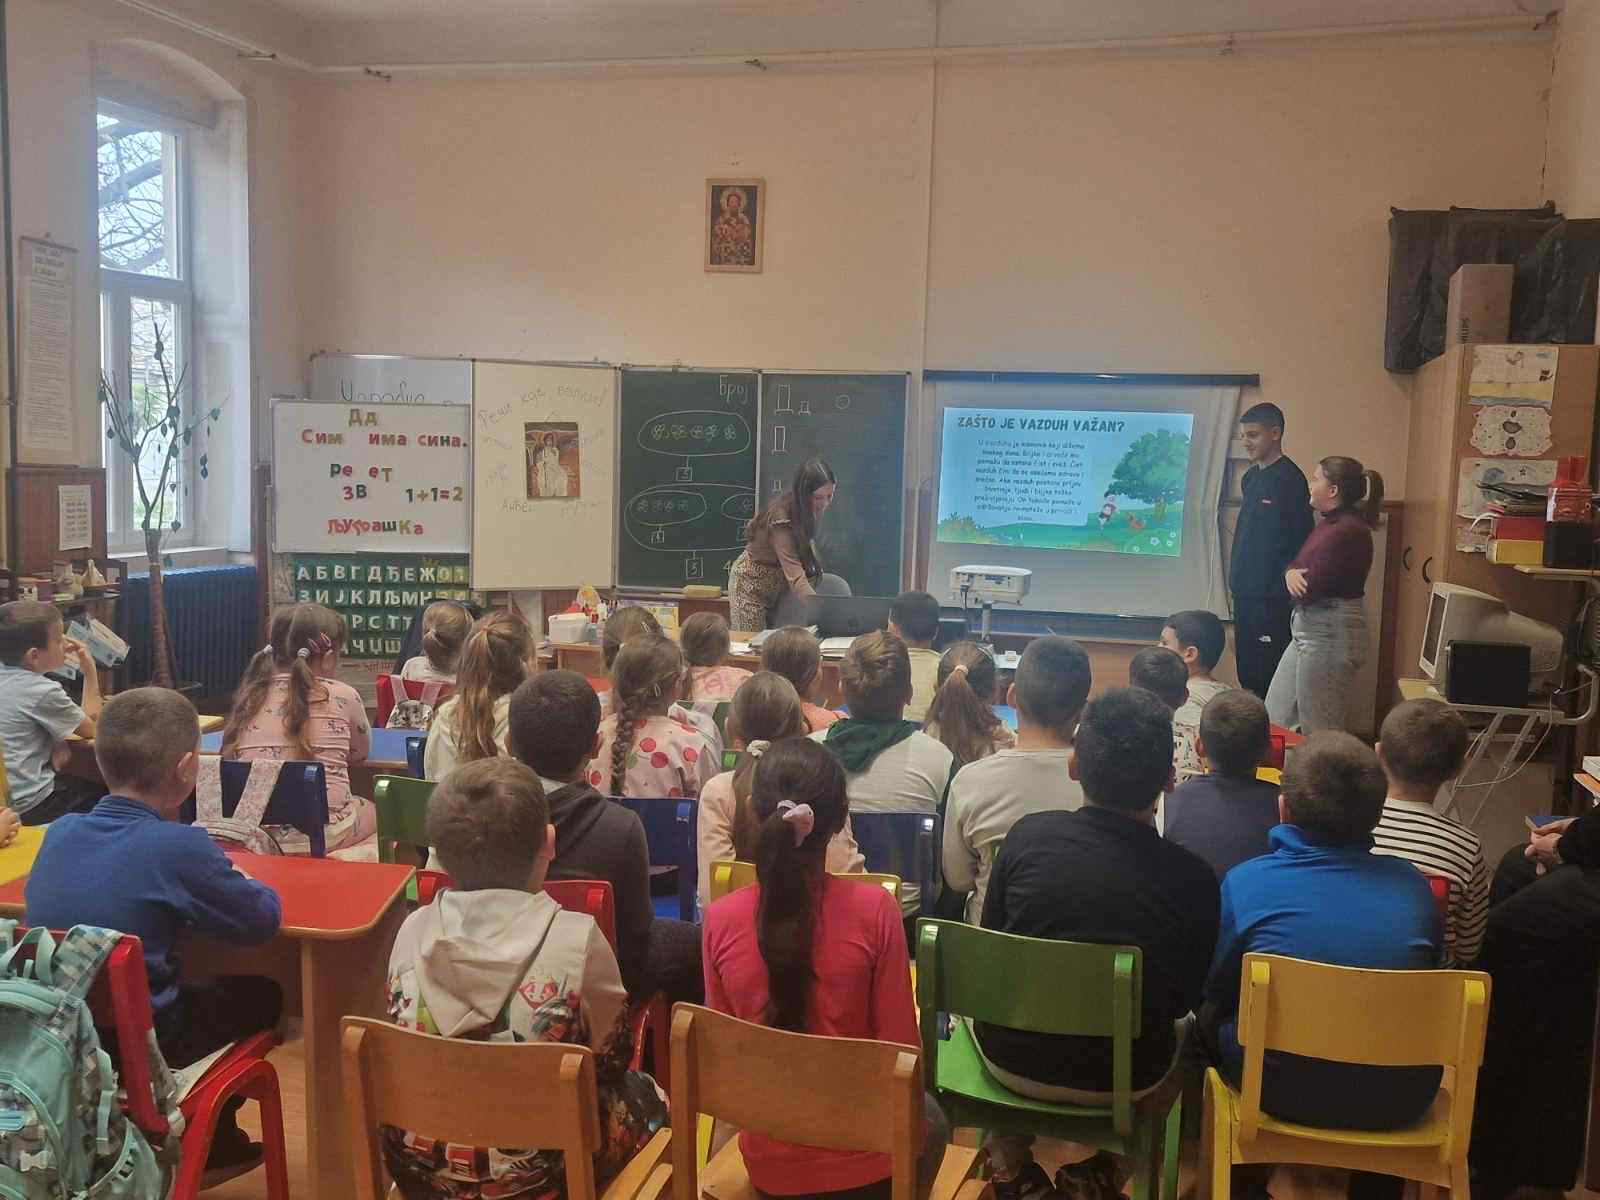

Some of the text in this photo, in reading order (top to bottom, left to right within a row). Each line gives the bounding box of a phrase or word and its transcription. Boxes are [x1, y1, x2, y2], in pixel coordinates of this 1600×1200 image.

[957, 414, 1125, 433] ZAŠTO JE VAZDUH VAŽAN?
[368, 433, 407, 446] има
[417, 434, 468, 448] сина.
[406, 487, 464, 503] 1+1=2
